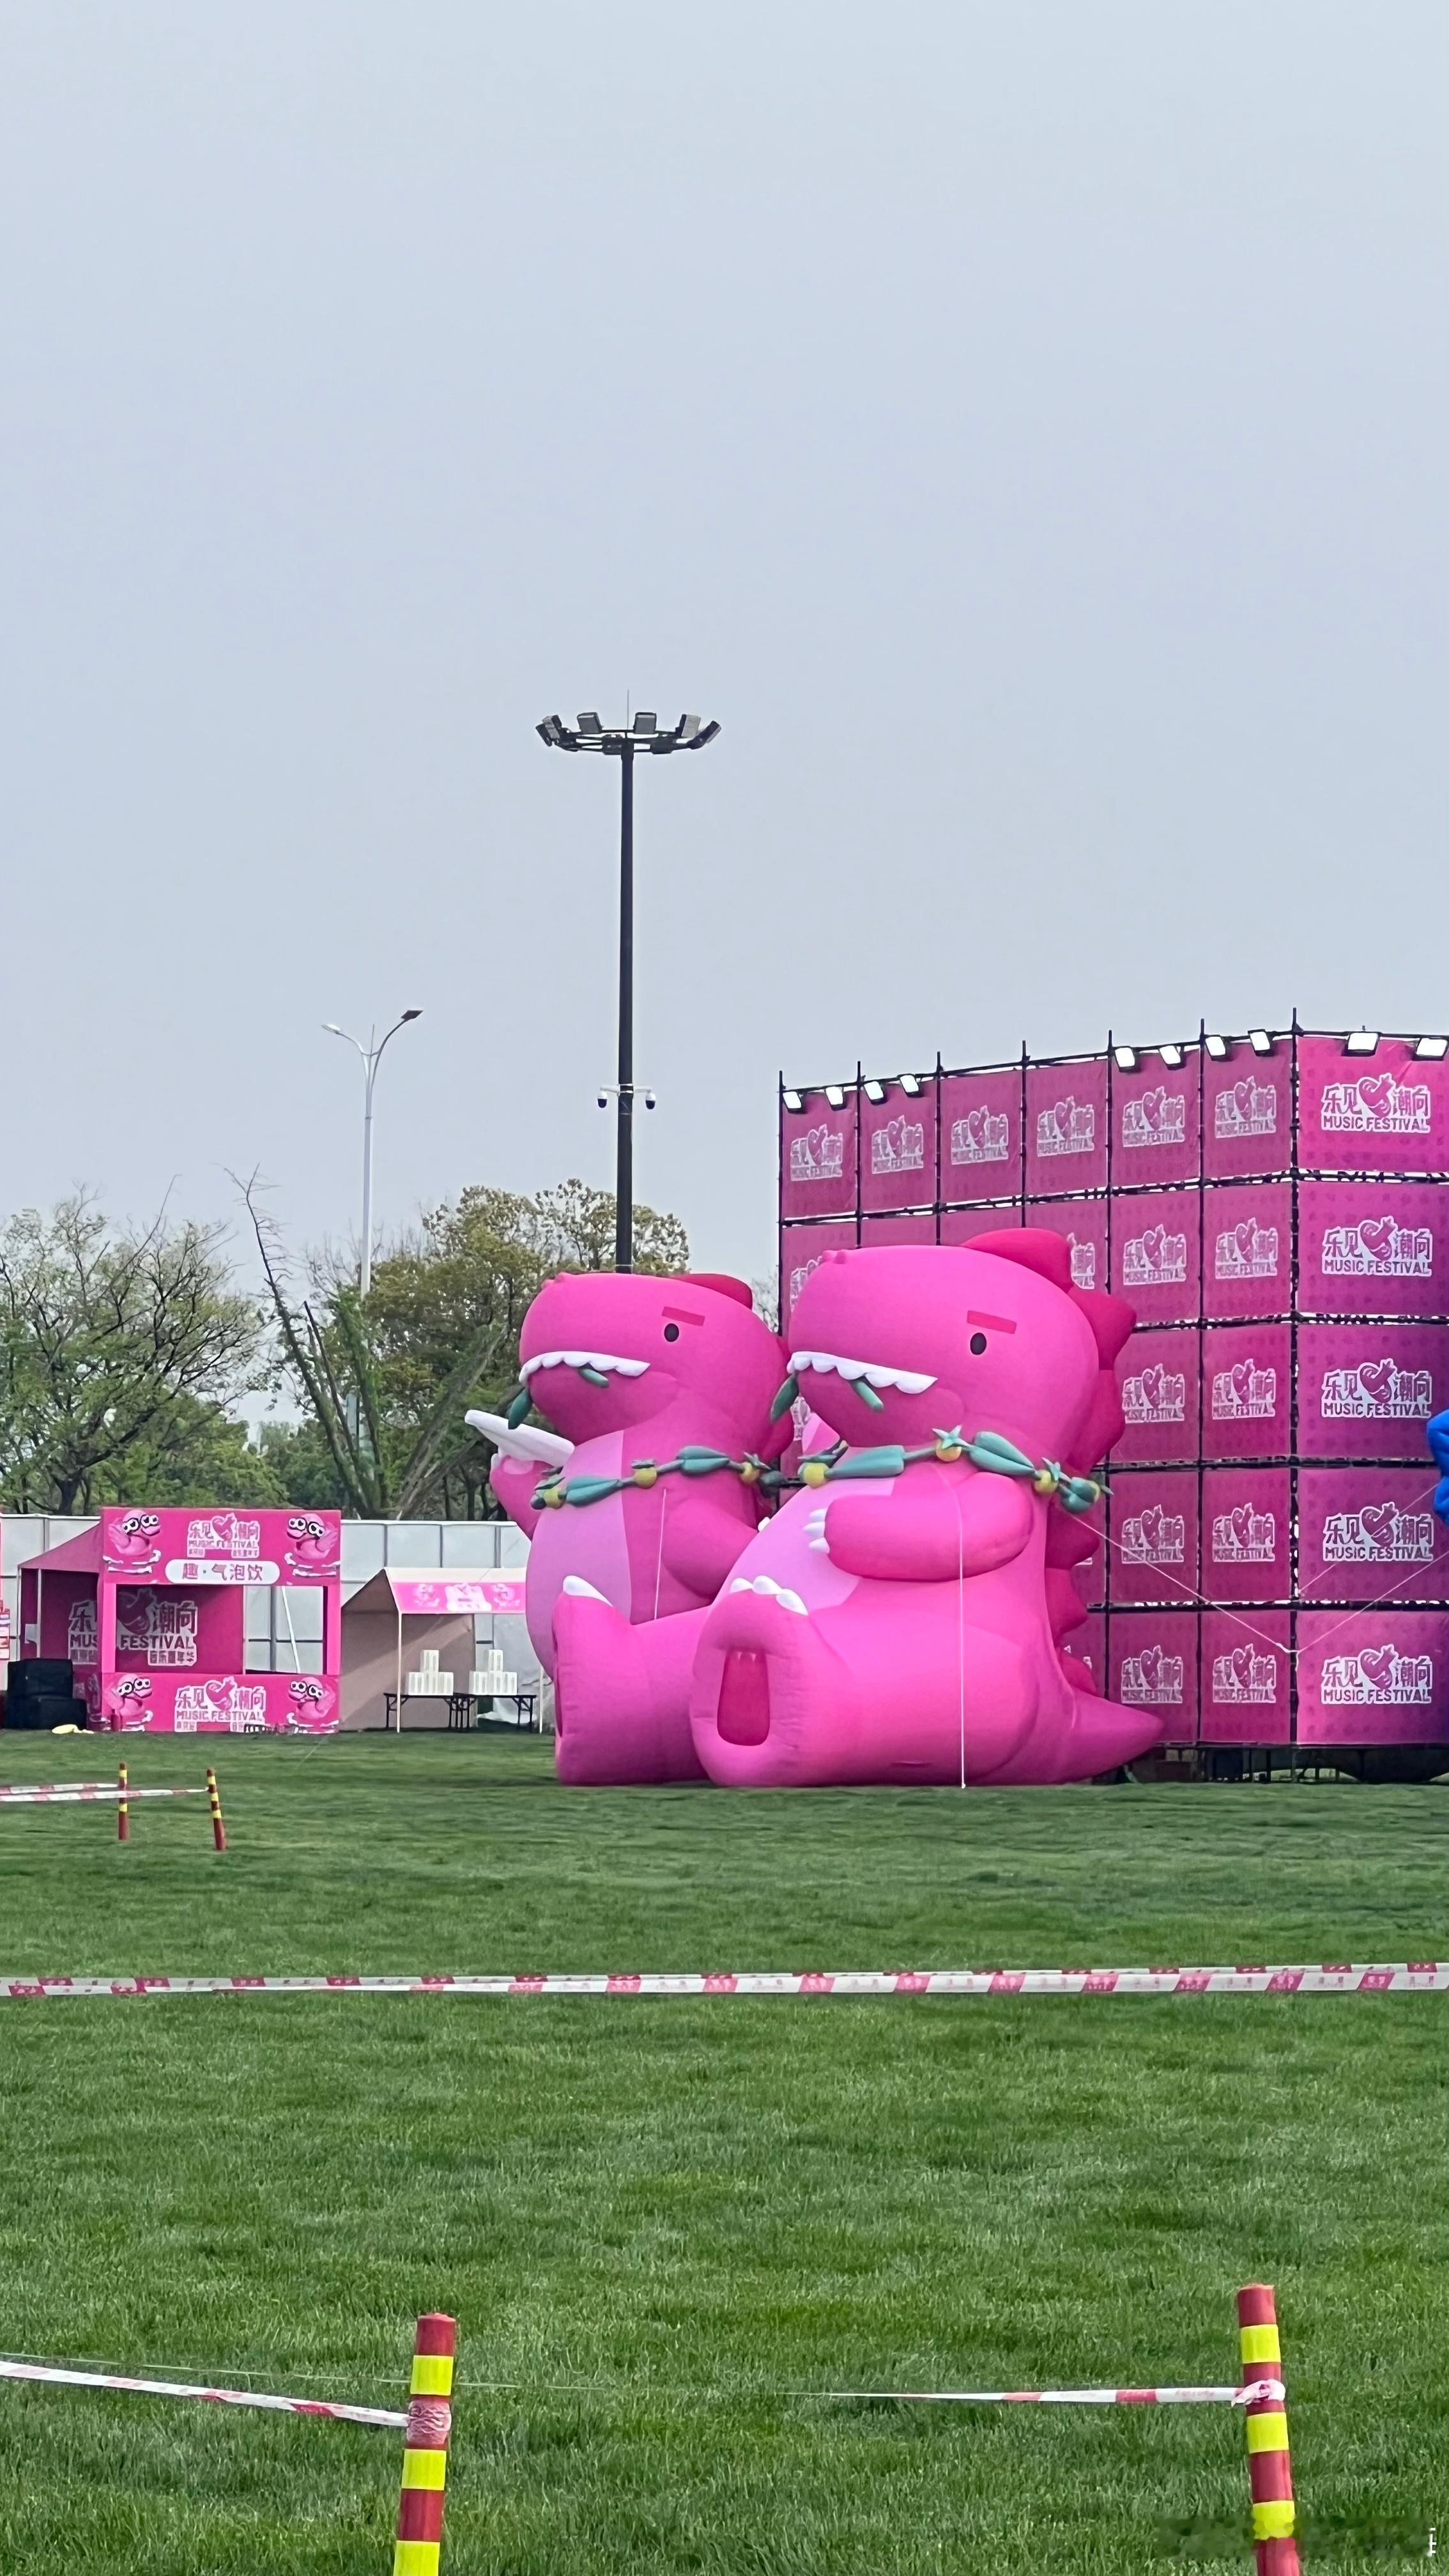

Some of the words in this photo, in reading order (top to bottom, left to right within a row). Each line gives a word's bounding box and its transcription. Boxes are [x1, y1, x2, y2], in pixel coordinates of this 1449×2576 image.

[1323, 1116, 1363, 1129] MUSIC
[1366, 1117, 1430, 1131] FESTIVAL
[1324, 1260, 1364, 1273] MUSIC
[1367, 1260, 1430, 1274] FESTIVAL
[1324, 1403, 1363, 1415] MUSIC
[1367, 1403, 1430, 1416] FESTIVAL
[1325, 1546, 1366, 1559] MUSIC
[1368, 1546, 1432, 1560] FESTIVAL
[120, 1634, 194, 1649] FESTIVAL
[1323, 1689, 1364, 1702] MUSIC
[1367, 1689, 1430, 1702] FESTIVAL
[176, 1710, 209, 1721] MUSIC
[211, 1711, 263, 1721] FESTIVAL
